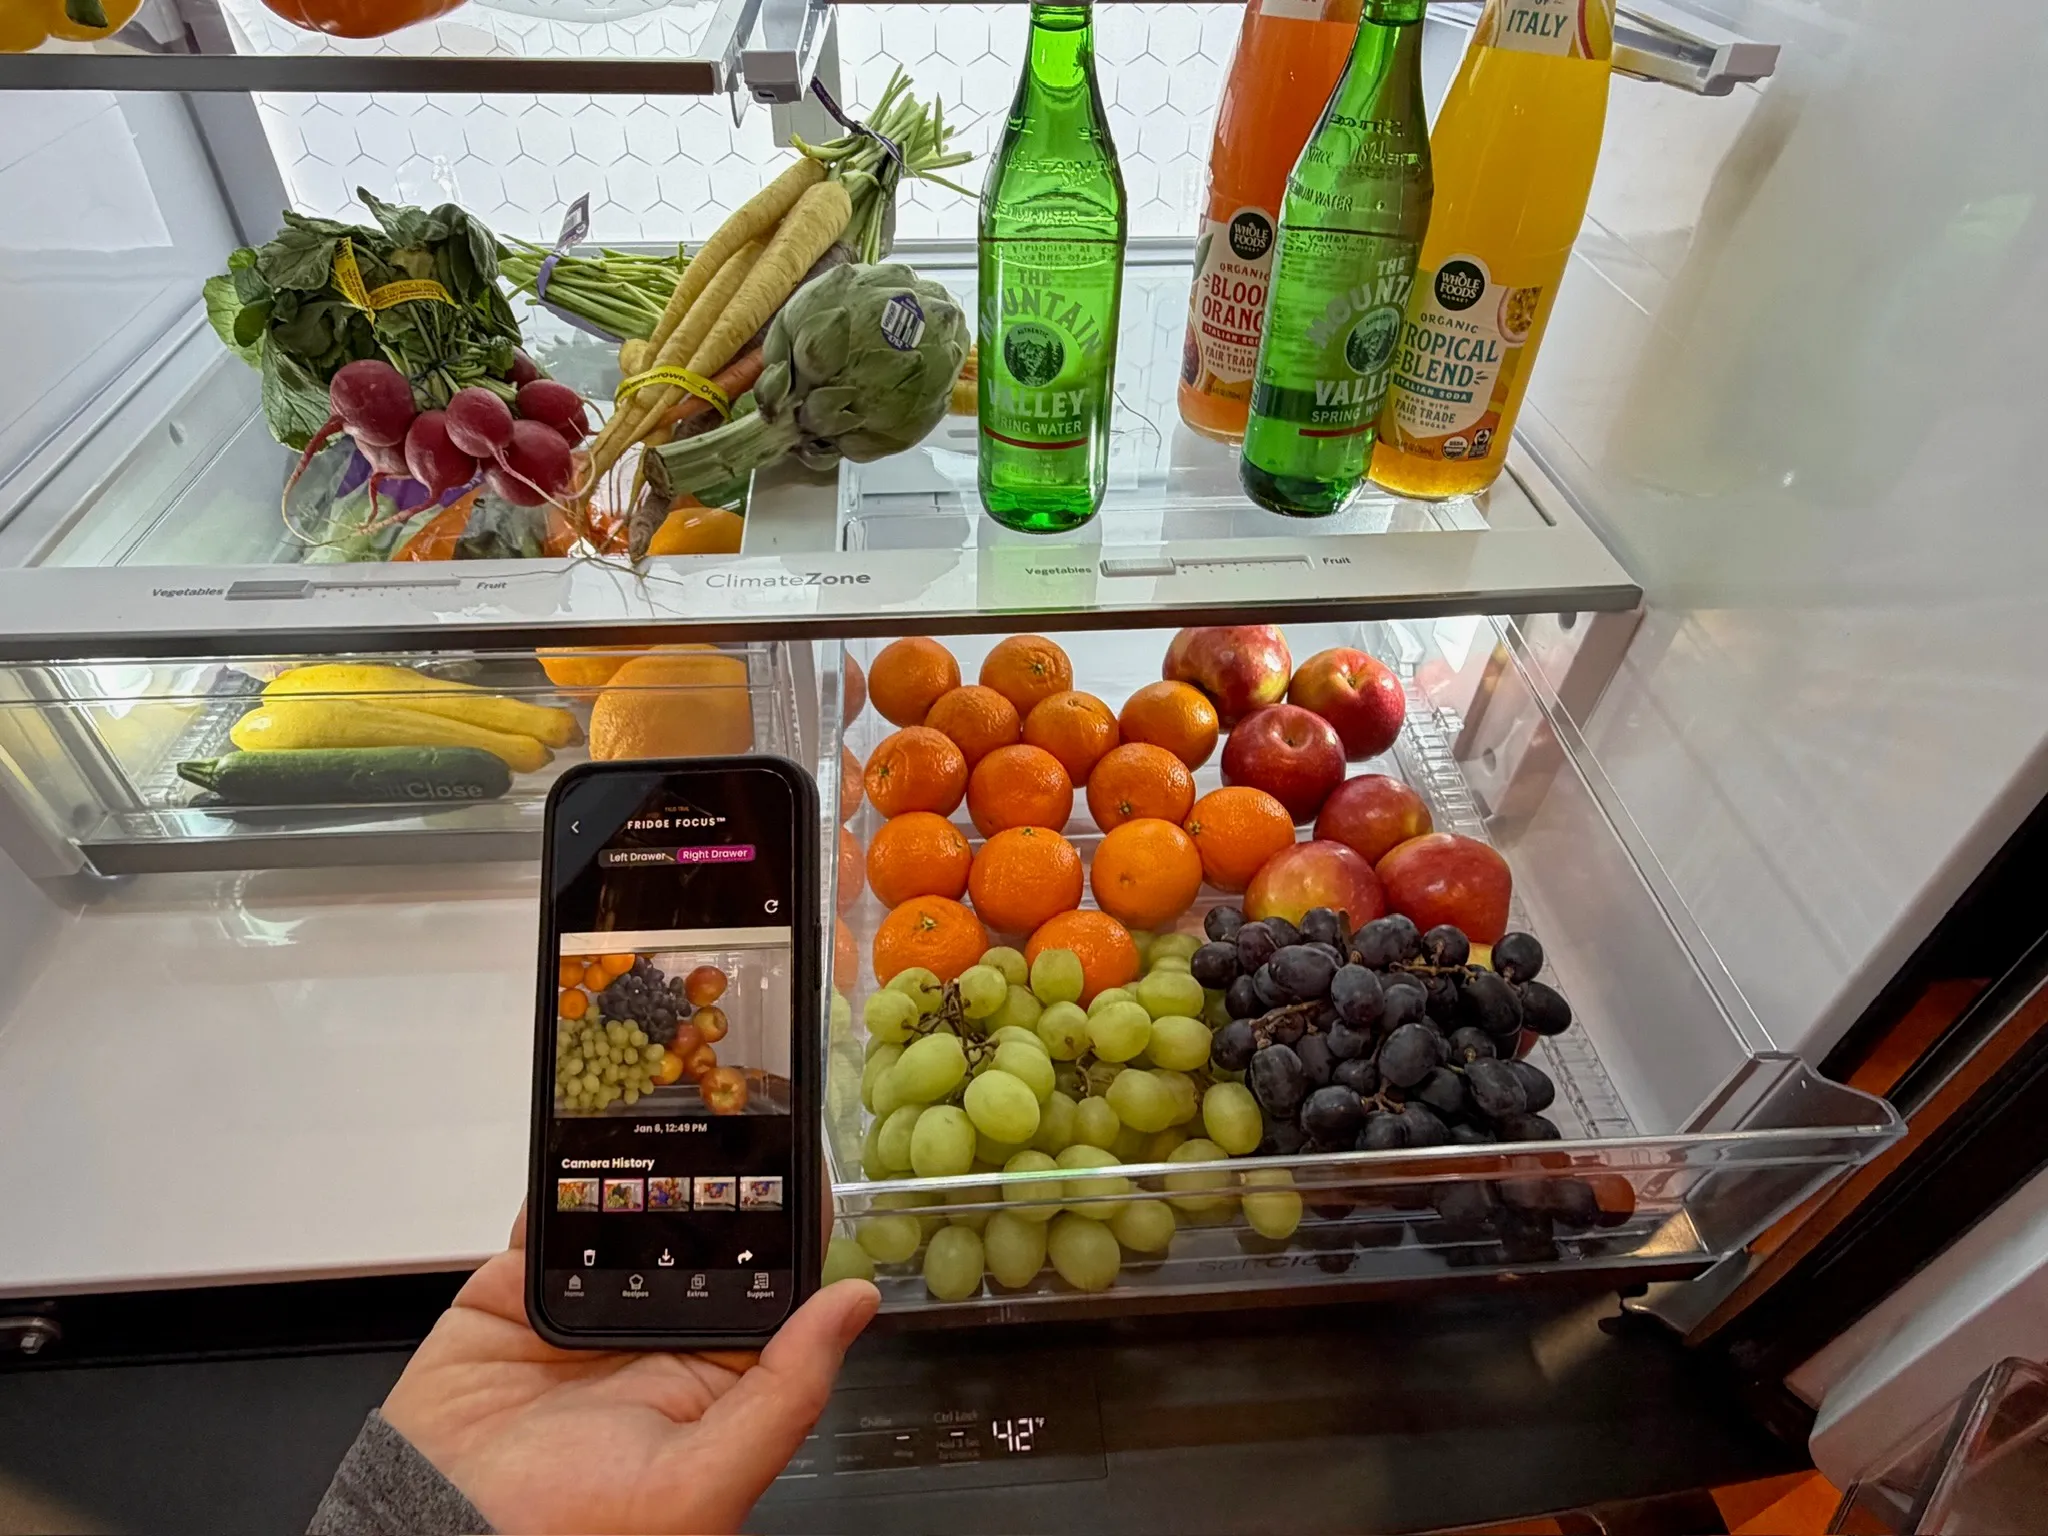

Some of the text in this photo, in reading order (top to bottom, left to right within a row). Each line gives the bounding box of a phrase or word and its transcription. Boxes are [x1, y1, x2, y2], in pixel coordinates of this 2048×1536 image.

[1506, 9, 1568, 38] ITALY
[1234, 223, 1270, 240] WHOLE
[1233, 232, 1267, 249] FOODS
[1377, 256, 1405, 276] THE
[1018, 267, 1052, 286] THE
[1441, 271, 1481, 290] WHOLE
[1440, 284, 1478, 299] FOODS
[1202, 295, 1264, 333] ORANG
[1306, 276, 1415, 349] MOUNTA
[979, 287, 1104, 358] MOUNTAIN
[1421, 312, 1479, 334] ORGANIC
[1017, 327, 1049, 338] AUTHENTIC
[1204, 324, 1238, 342] ITALIAN
[1206, 345, 1224, 361] FAIR
[1401, 349, 1475, 388] BLEND
[1316, 368, 1391, 406] VALLE
[1396, 375, 1468, 401] ITALIAN SODA
[987, 378, 1086, 418] VALLEY
[1312, 399, 1386, 423] SPRING WAT
[1395, 398, 1456, 424] FAIR TRADE
[1037, 421, 1082, 435] WATER
[1322, 557, 1351, 566] Fruit
[706, 571, 872, 589] ClimateZone
[1025, 566, 1092, 577] Vegetables
[152, 586, 225, 597] Vegetables
[476, 581, 507, 590] Fruit
[627, 819, 670, 830] FRIDGE
[610, 851, 666, 862] Left Drawer
[683, 848, 748, 861] Right Drawer
[634, 1124, 653, 1133] Jan
[665, 1123, 691, 1133] 12:49
[692, 1123, 708, 1132] PM
[561, 1157, 655, 1171] Camera History
[564, 1290, 585, 1298] Home
[622, 1290, 649, 1299] Recipes
[687, 1290, 709, 1298] Extras
[746, 1290, 775, 1299] Support
